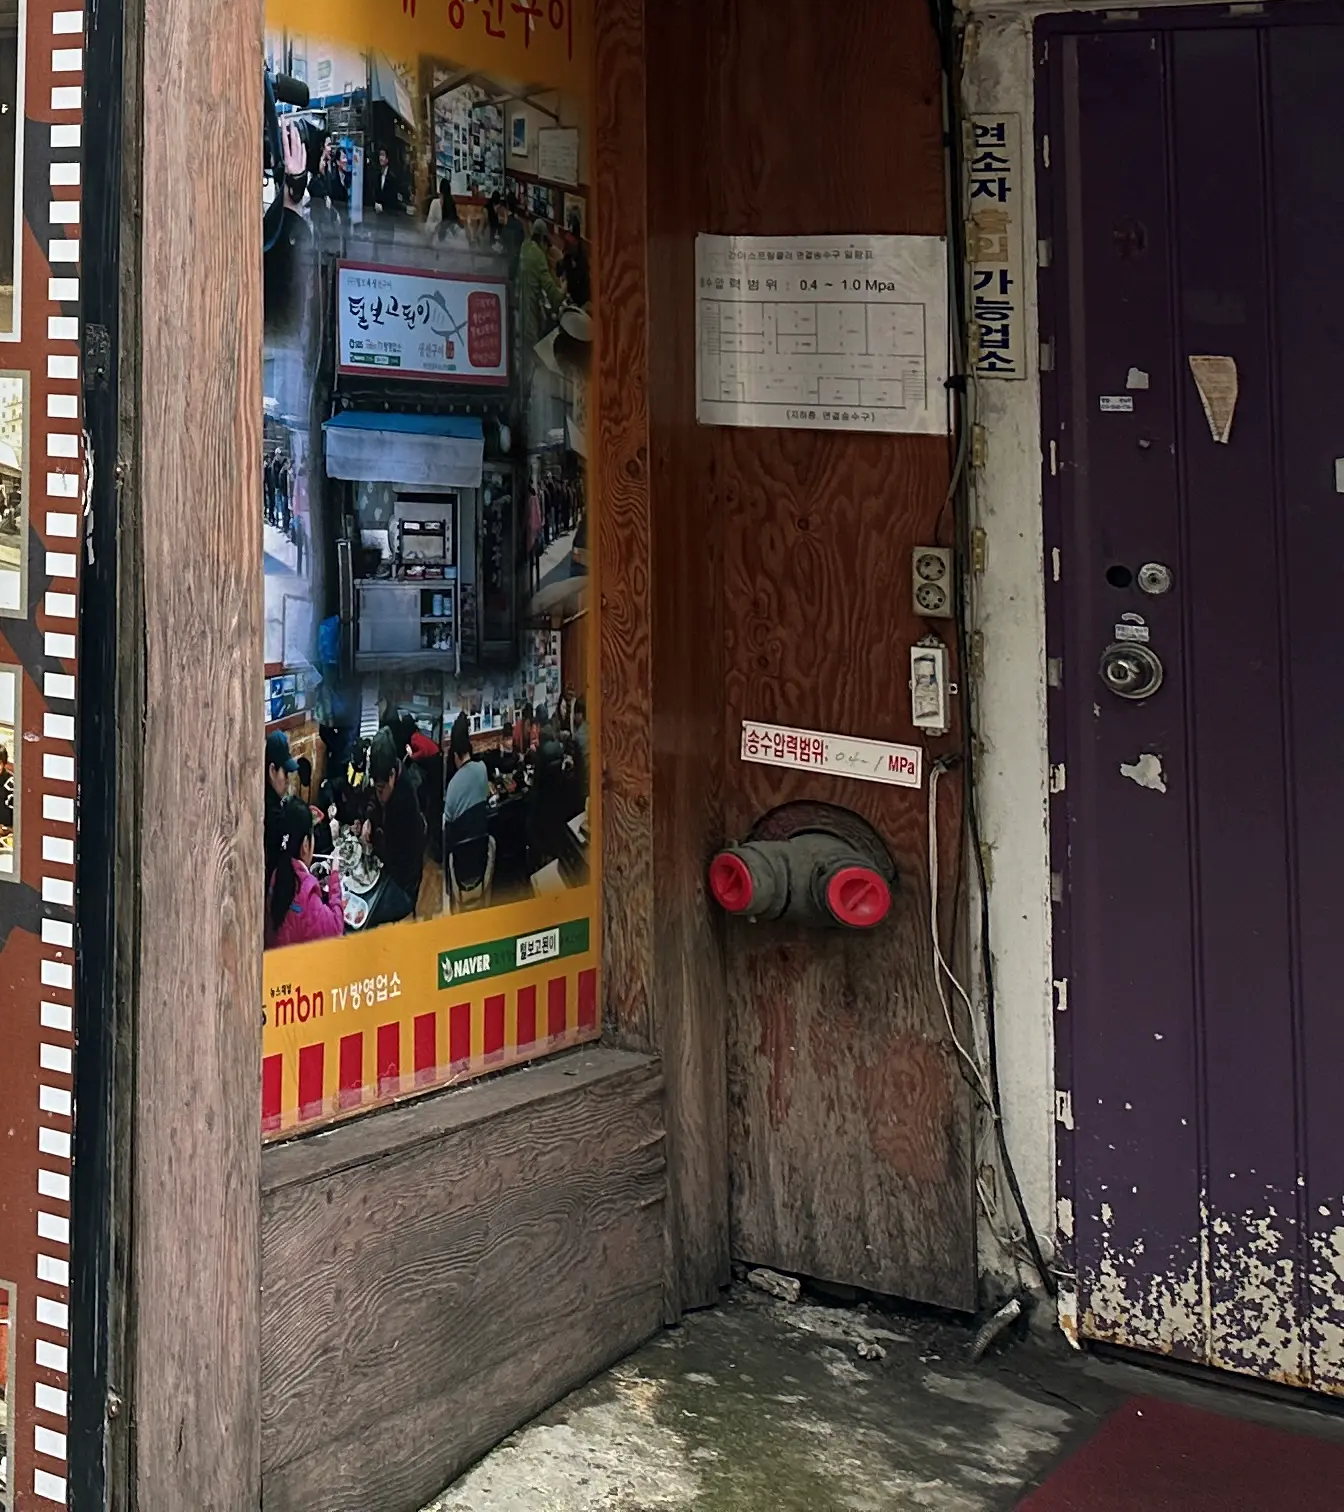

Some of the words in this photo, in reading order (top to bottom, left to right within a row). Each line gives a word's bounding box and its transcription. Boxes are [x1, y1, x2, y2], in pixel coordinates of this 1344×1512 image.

[969, 122, 1012, 203] 연소자
[865, 279, 896, 293] Mpa
[972, 268, 1017, 373] 가능업소
[887, 754, 916, 776] MPa
[453, 953, 491, 978] NAVER
[275, 986, 324, 1028] mbn
